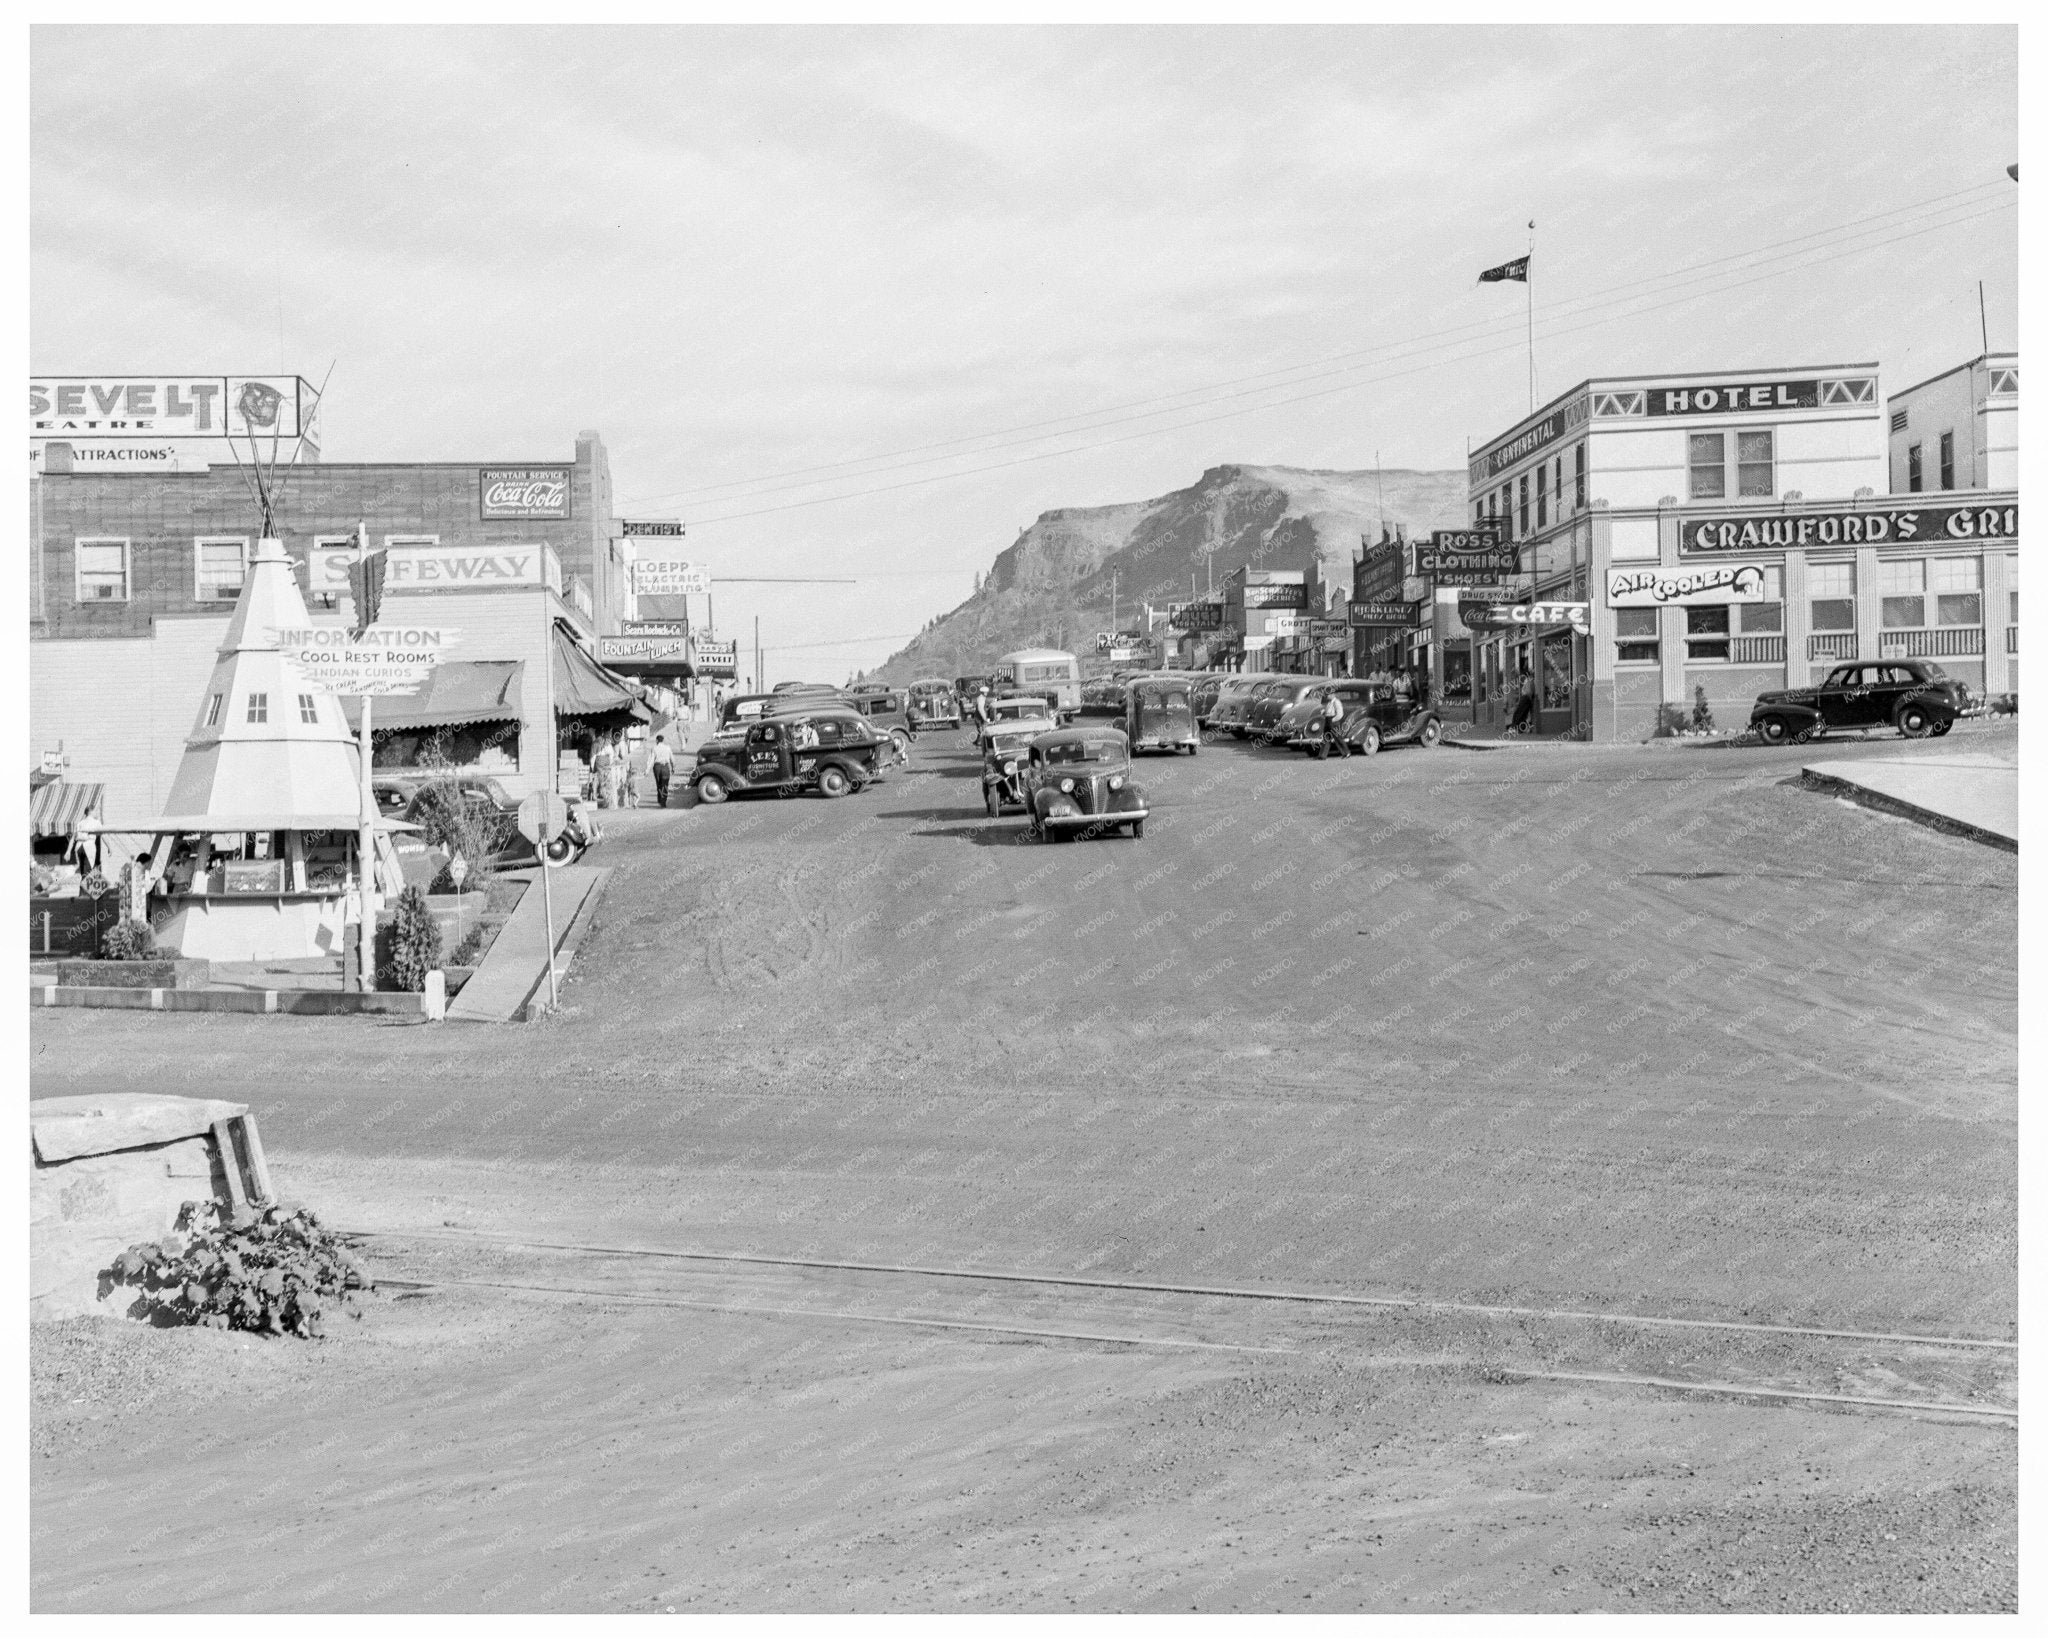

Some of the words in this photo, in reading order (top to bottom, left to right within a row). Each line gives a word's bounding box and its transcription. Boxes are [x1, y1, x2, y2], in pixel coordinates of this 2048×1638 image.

[1665, 384, 1798, 411] HOTEL
[1497, 420, 1555, 468] CONTINENTAL
[486, 472, 527, 480] FOUNTAIN
[530, 472, 564, 480] SERVICE
[484, 482, 566, 508] Coca-Cola
[627, 524, 681, 536] DENTIST
[1696, 511, 1919, 548] CRAWFORD'S
[1440, 533, 1494, 548] ROSS
[324, 554, 531, 583] SFEWAY
[636, 562, 690, 573] LOEPP
[1421, 554, 1513, 569] CLOTHING
[636, 574, 700, 583] ELECTRIC
[1442, 573, 1492, 584] SHOES
[1610, 572, 1656, 598] AIR
[1652, 568, 1735, 602] COOLED
[1512, 606, 1584, 623] CAFE
[604, 640, 655, 656] FOUNTAIN
[650, 642, 681, 660] LUNCH
[300, 651, 340, 662] COOL
[345, 651, 380, 662] REST
[386, 651, 435, 662] ROOMS
[313, 668, 360, 678] INDIAN
[365, 668, 412, 678] CURIOS
[750, 752, 778, 763] LEE'S
